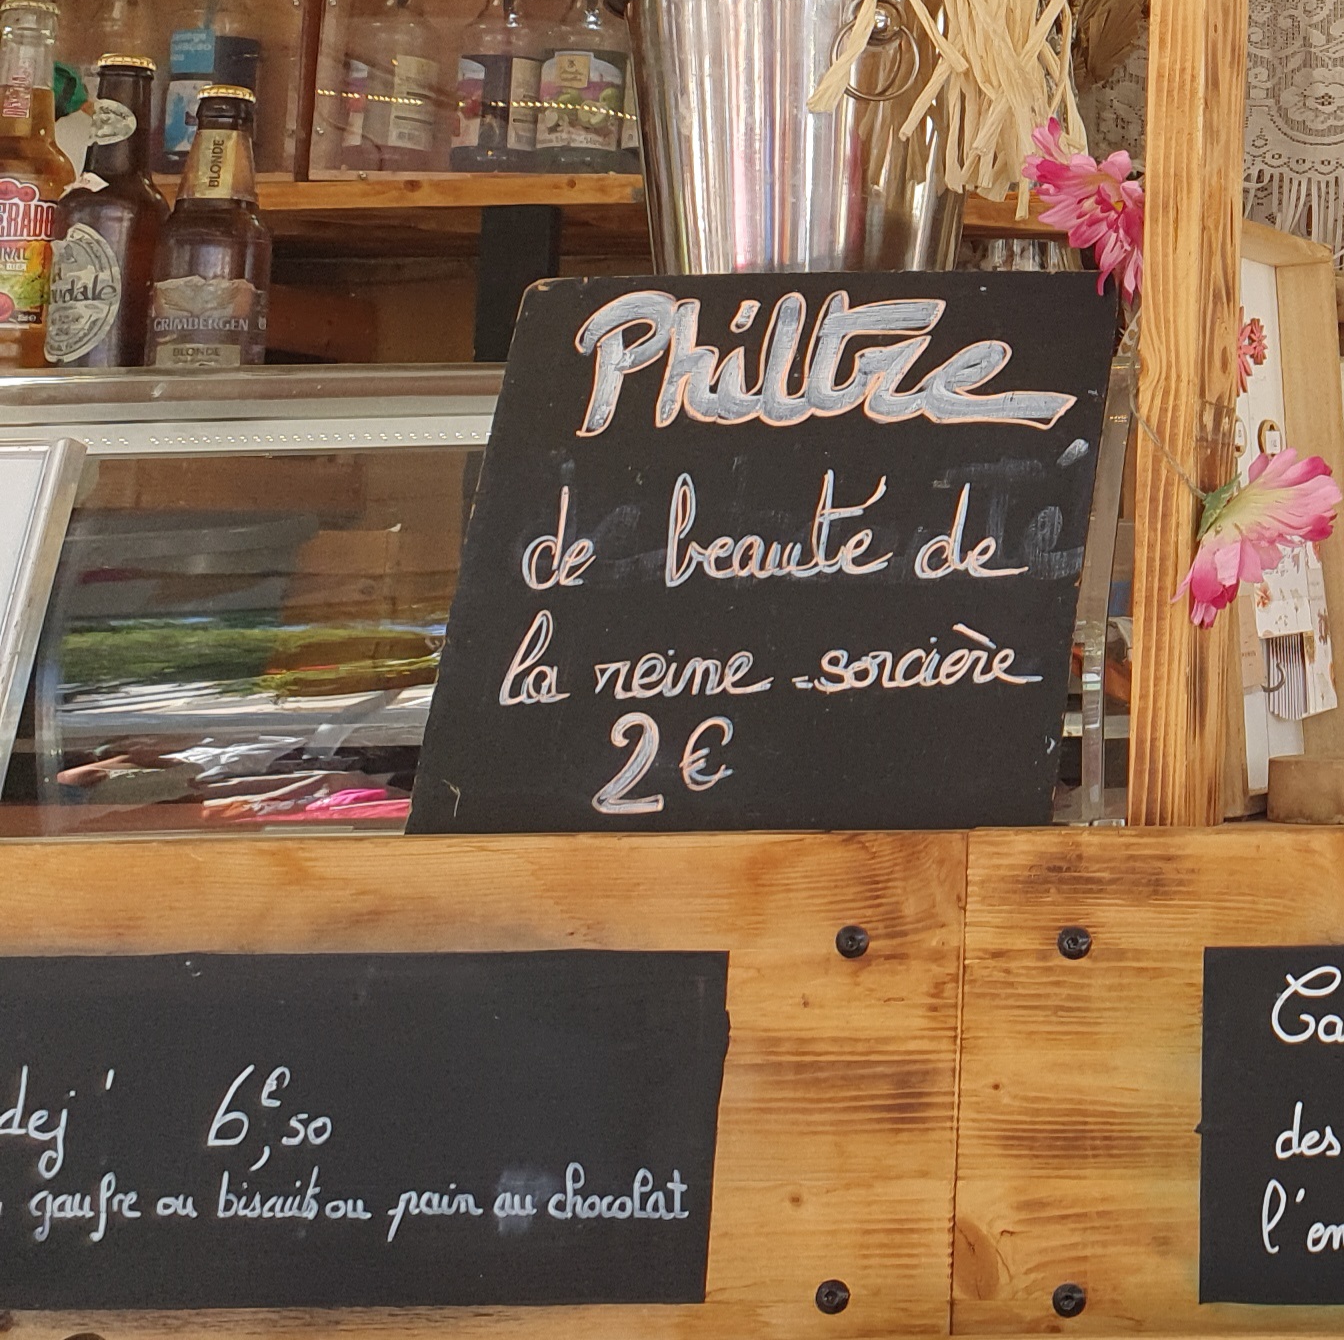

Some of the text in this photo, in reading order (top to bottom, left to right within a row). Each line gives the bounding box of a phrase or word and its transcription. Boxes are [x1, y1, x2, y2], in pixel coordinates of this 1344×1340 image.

[208, 139, 225, 188] BLONDE
[153, 316, 249, 331] GRIMBERGEN
[522, 469, 1028, 590] de beauté de
[499, 609, 570, 706] la
[594, 649, 774, 697] reine
[1274, 1101, 1342, 1158] des
[27, 1171, 142, 1243] gaufre
[155, 1196, 197, 1219] ou
[325, 1198, 372, 1220] ou
[387, 1190, 484, 1243] pain
[493, 1191, 537, 1218] au
[547, 1161, 690, 1220] chocolat
